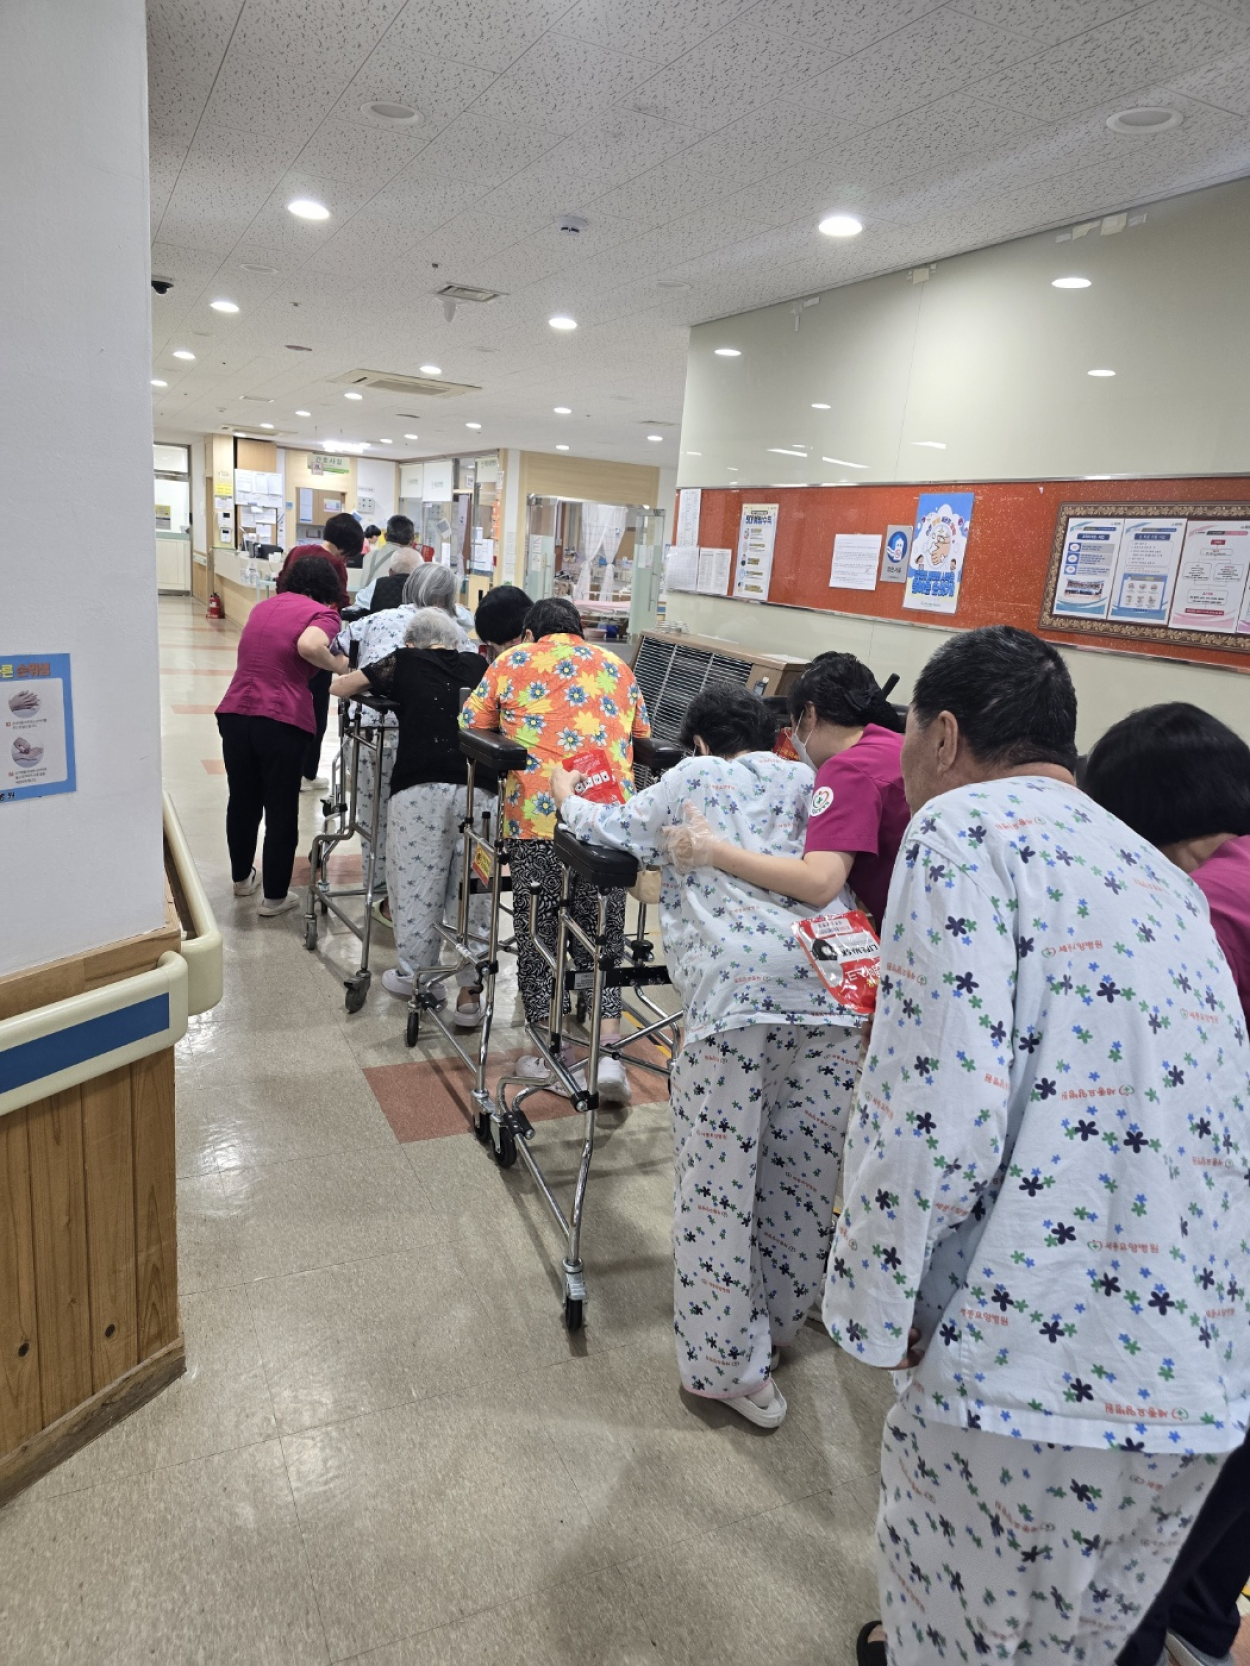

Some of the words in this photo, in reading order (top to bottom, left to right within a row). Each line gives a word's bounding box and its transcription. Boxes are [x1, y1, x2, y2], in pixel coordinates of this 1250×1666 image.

[316, 456, 342, 466] 간호사실
[1060, 1087, 1116, 1101] 세종요양병원
[1106, 1242, 1159, 1253] 세종요양병원
[1105, 1403, 1167, 1418] 세종요양병원
